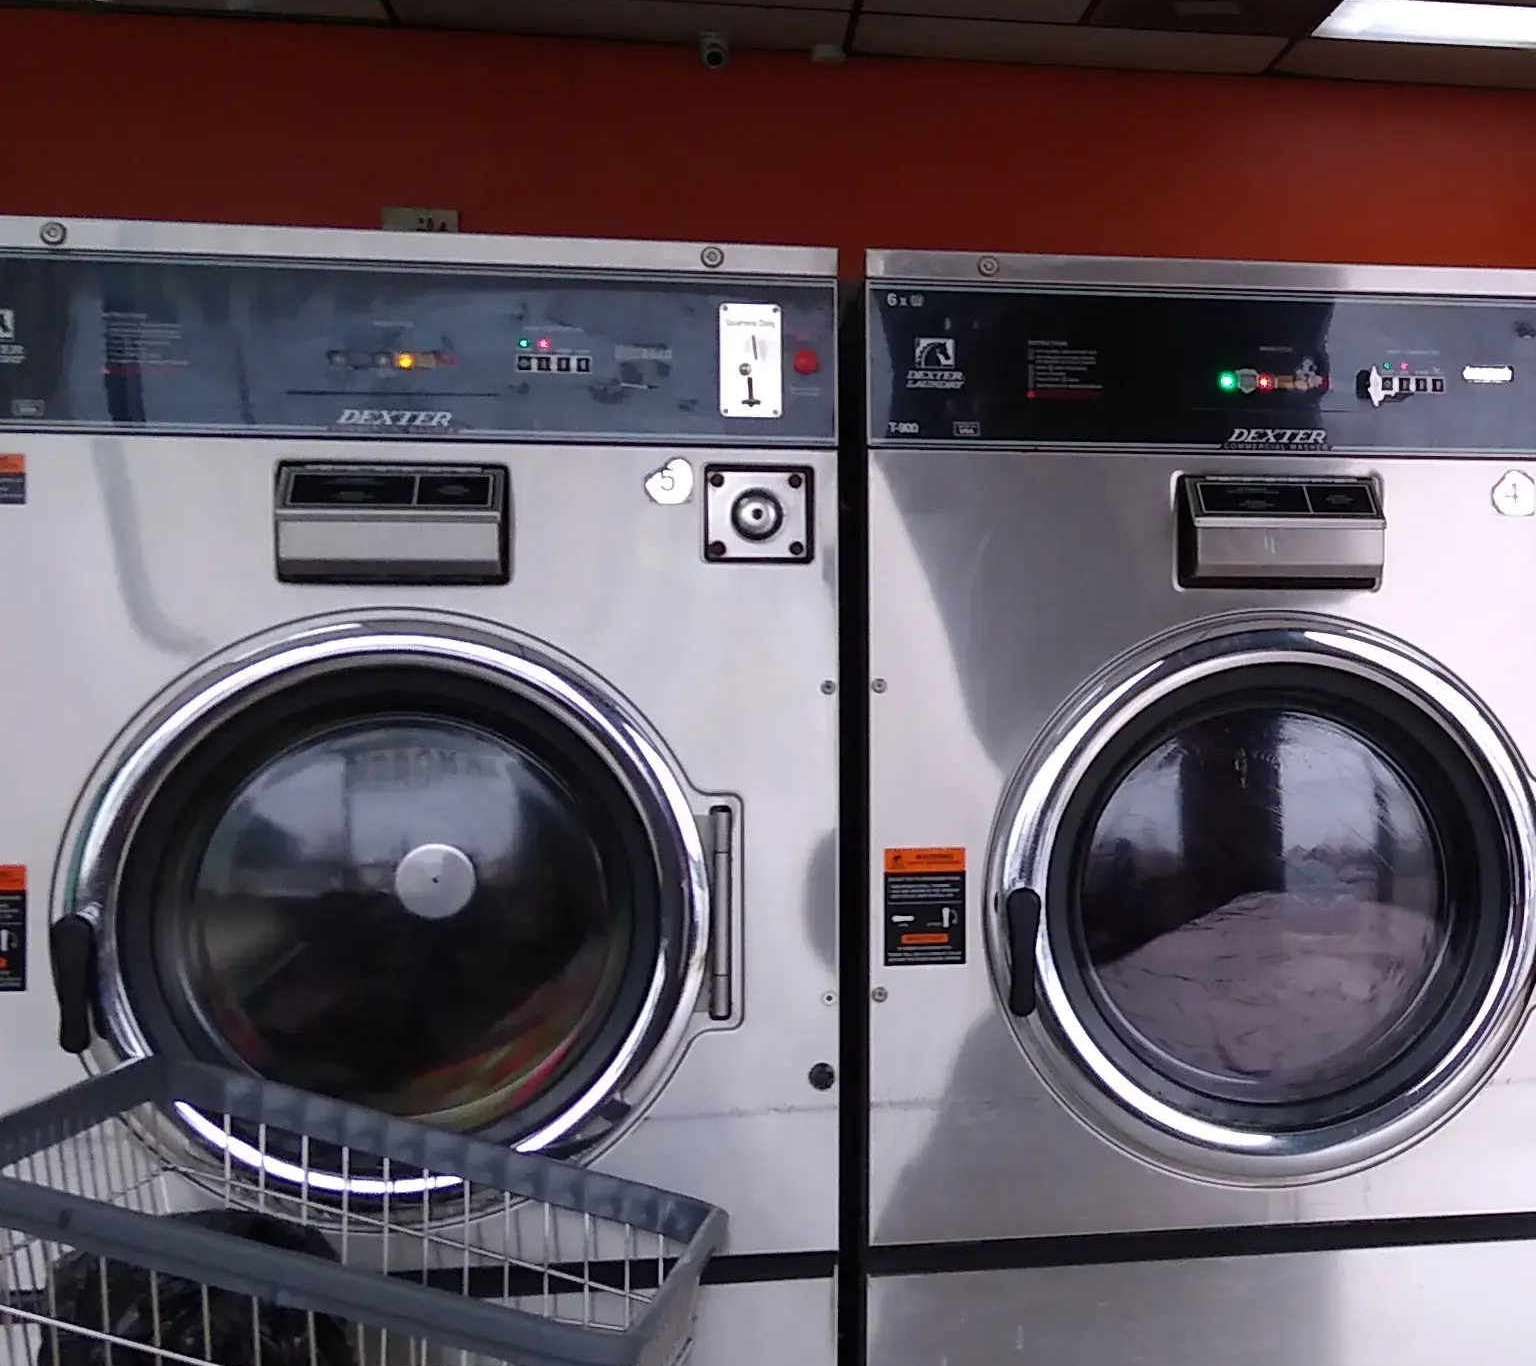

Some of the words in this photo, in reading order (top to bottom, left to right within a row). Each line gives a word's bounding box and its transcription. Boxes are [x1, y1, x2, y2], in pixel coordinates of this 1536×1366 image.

[887, 293, 898, 307] 6
[906, 370, 963, 380] DEXTER
[336, 409, 453, 427] DEXTER
[1227, 428, 1327, 444] DEXTER
